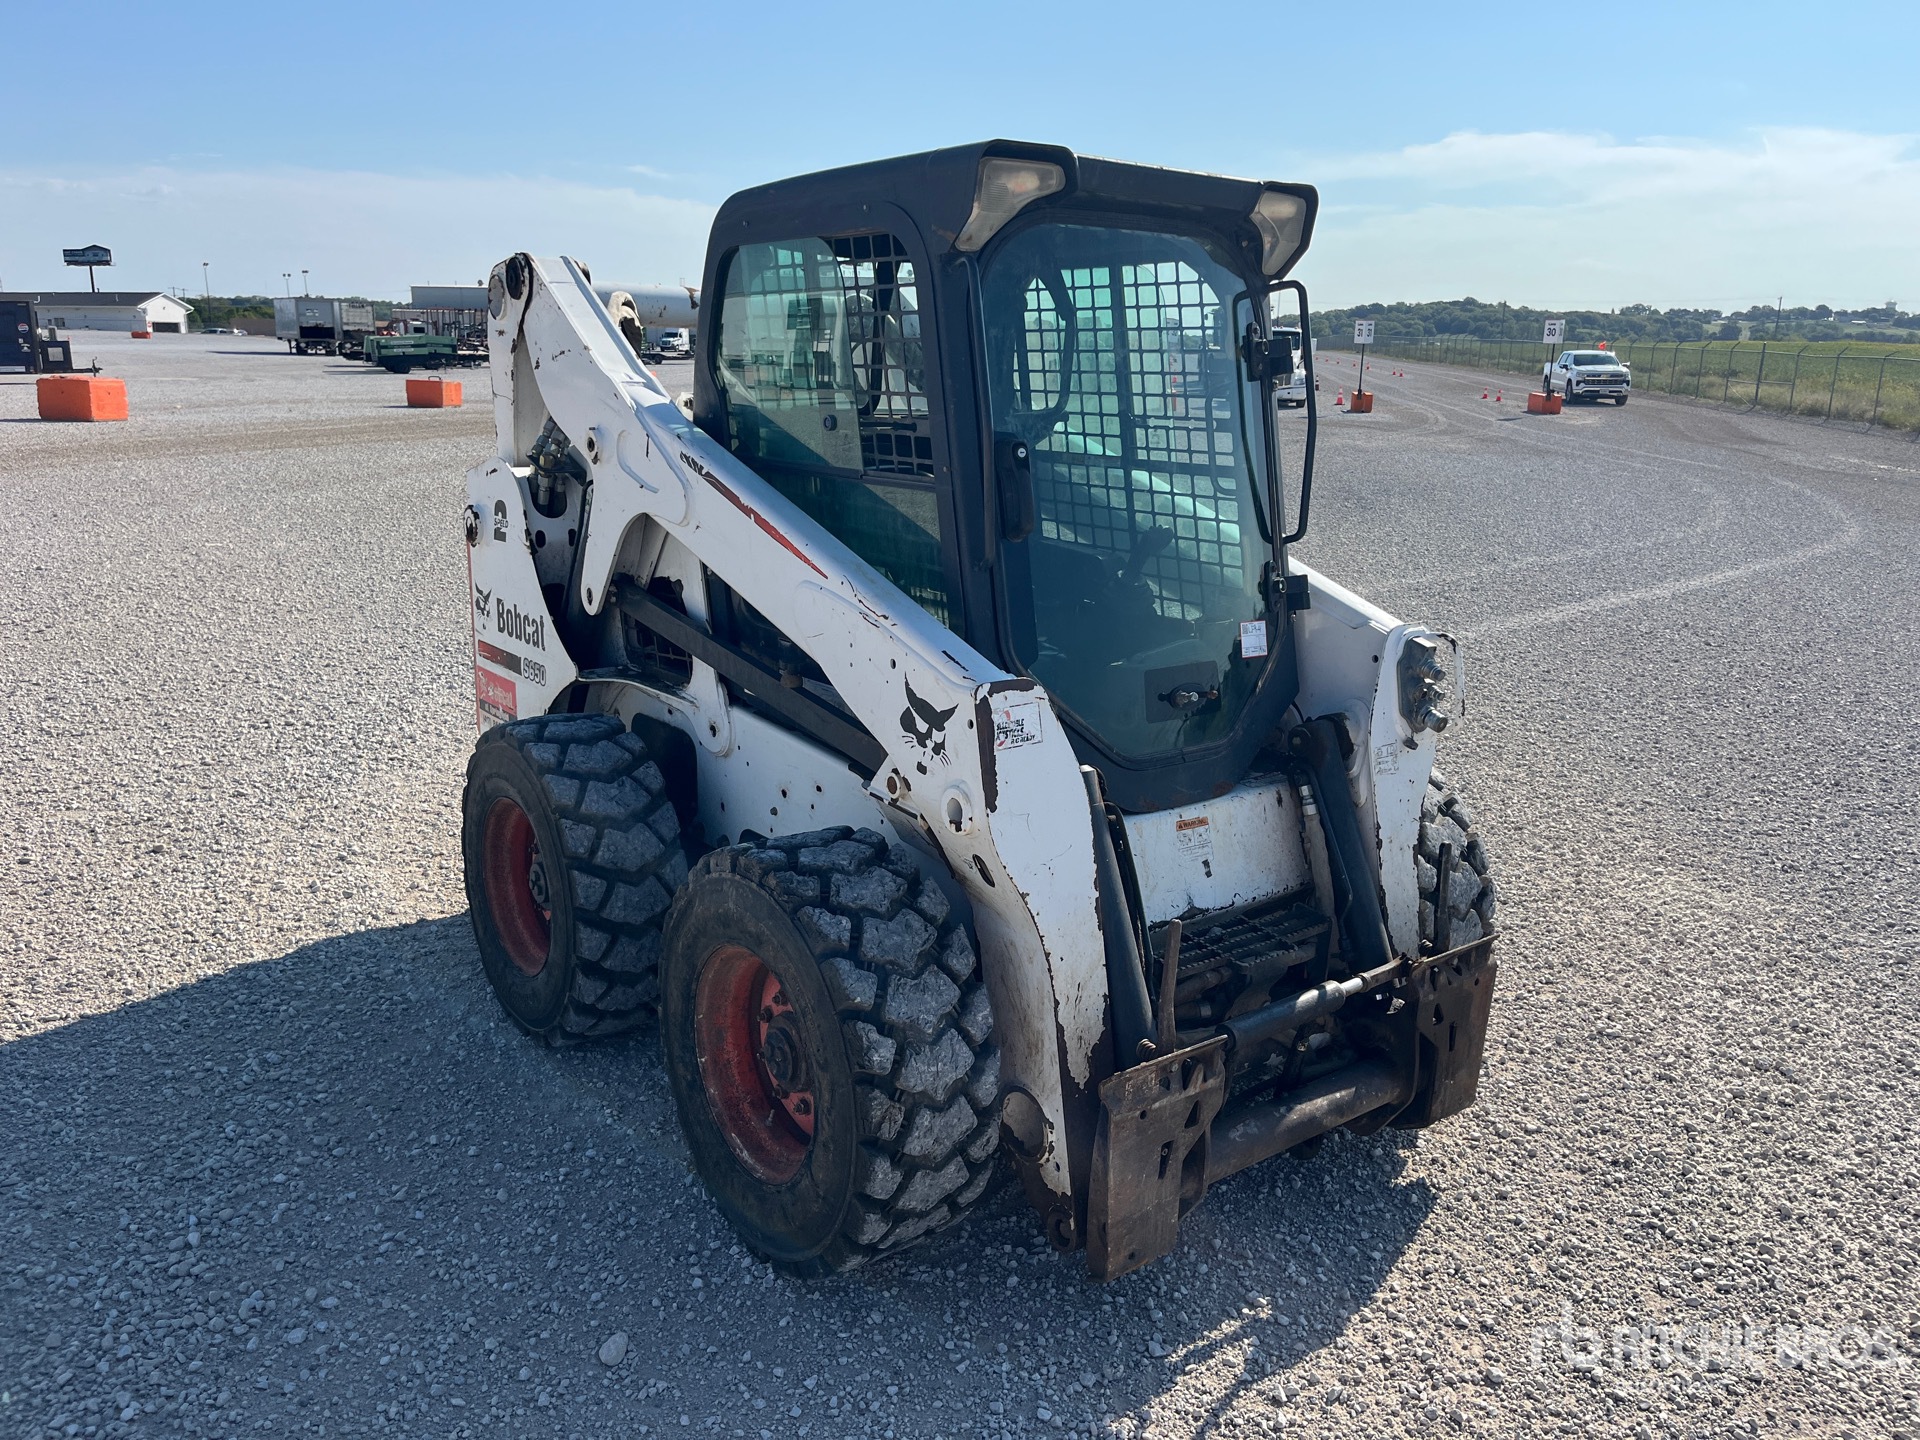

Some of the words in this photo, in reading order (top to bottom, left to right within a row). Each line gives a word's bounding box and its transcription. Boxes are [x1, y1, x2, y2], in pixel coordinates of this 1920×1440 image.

[1546, 327, 1556, 337] 30
[496, 597, 546, 652] Bobcat
[523, 657, 547, 687] S650
